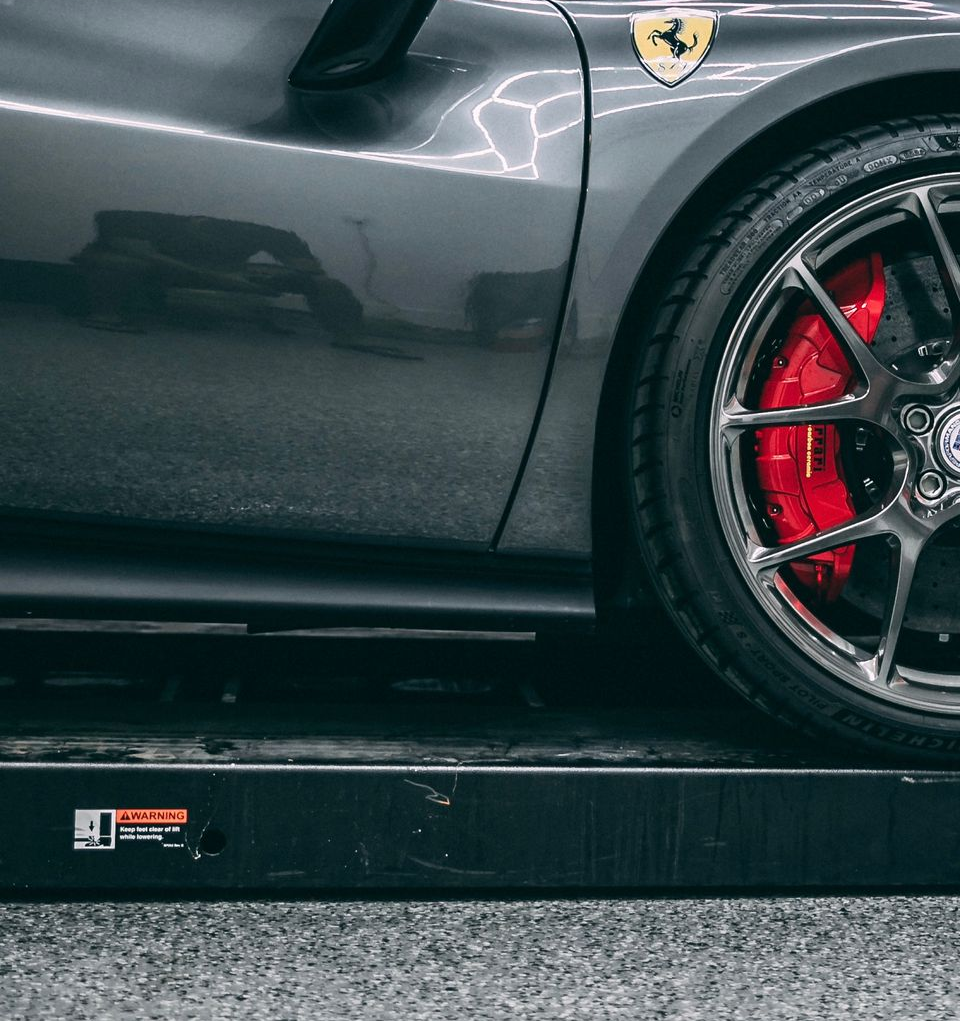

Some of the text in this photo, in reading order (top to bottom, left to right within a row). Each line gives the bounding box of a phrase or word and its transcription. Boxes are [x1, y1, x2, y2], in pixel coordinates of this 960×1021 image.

[719, 241, 746, 276] TREADWEAR
[764, 199, 791, 222] TRACTION
[809, 160, 852, 186] TEMPERATURE
[750, 647, 790, 684] SPORT
[791, 684, 826, 710] PILOT
[131, 812, 184, 820] WARNING
